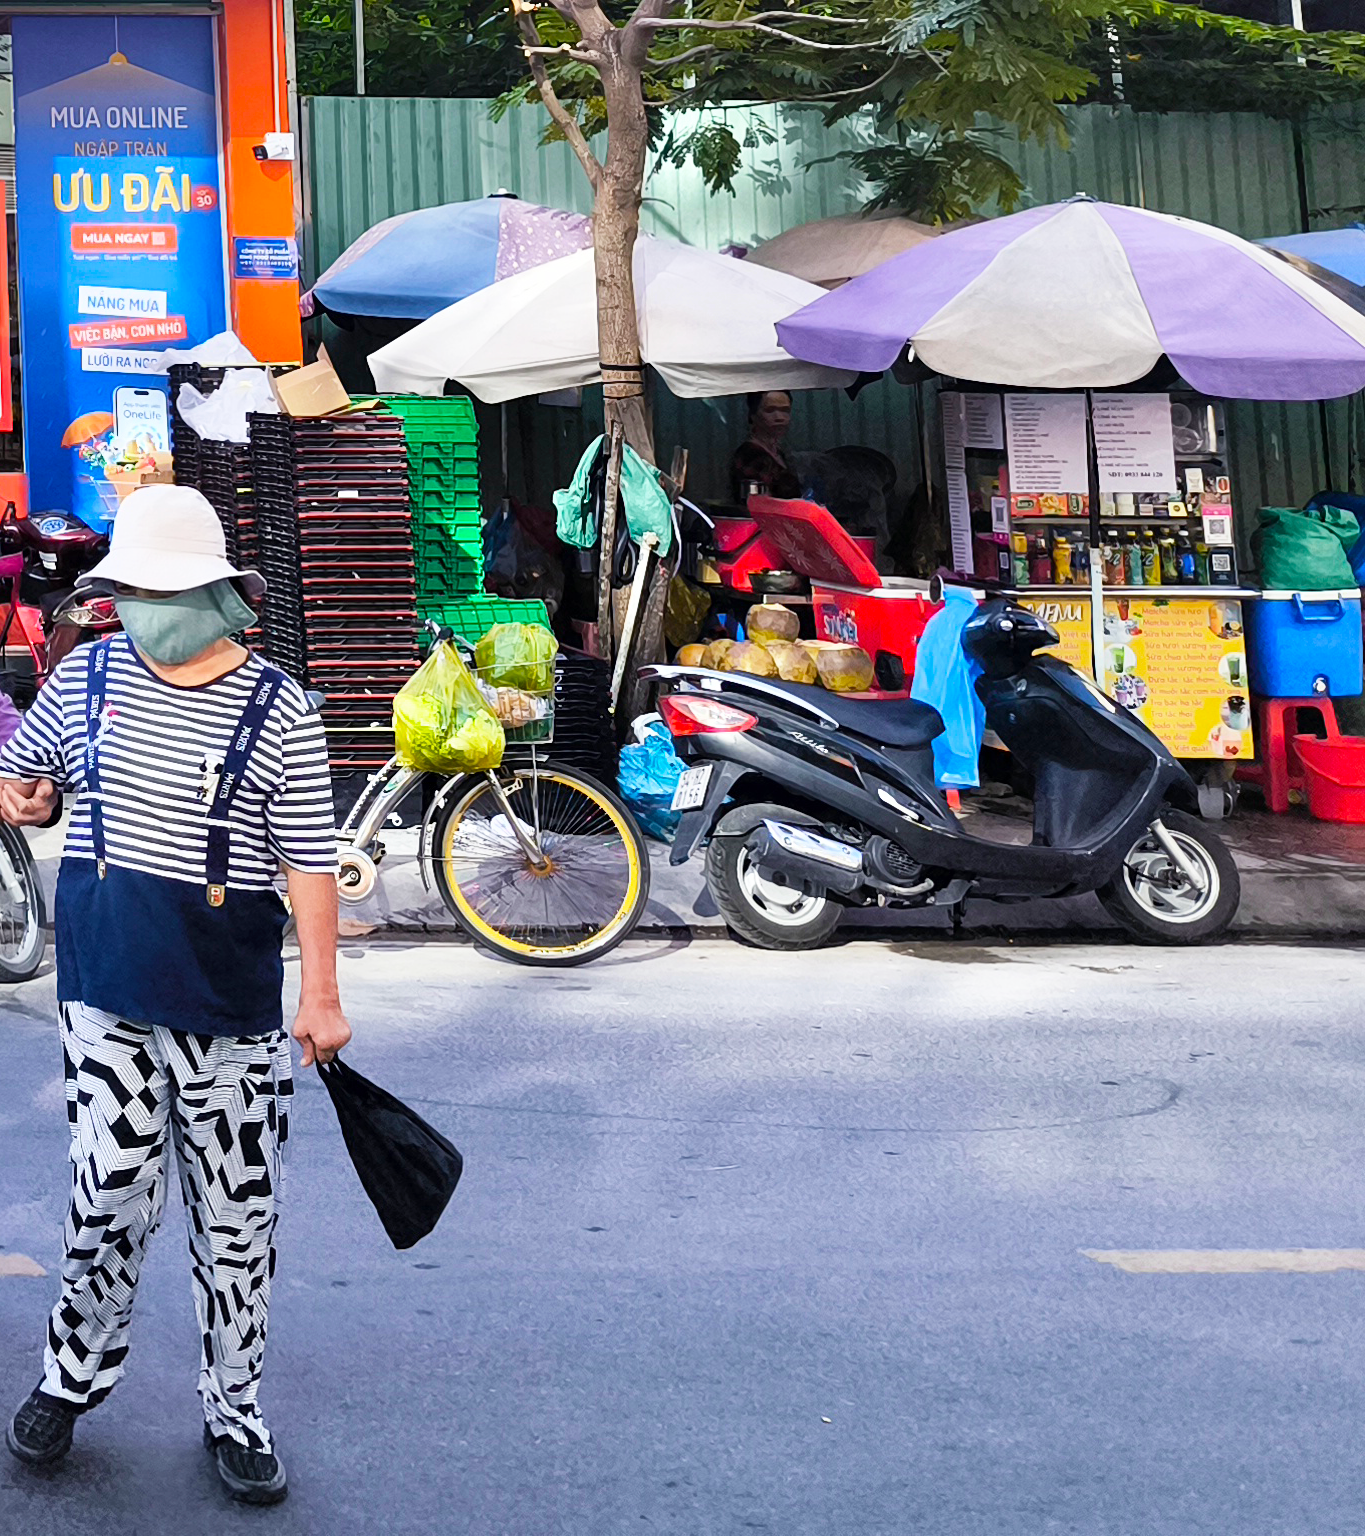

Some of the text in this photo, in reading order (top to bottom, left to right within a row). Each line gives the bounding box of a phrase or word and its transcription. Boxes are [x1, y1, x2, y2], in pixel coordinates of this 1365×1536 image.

[50, 106, 189, 129] MUA ONLINE
[74, 139, 168, 160] NGẬP TRÀN
[53, 166, 191, 212] ƯU ĐÃI
[196, 196, 212, 207] 30
[82, 233, 149, 243] MUA NGAY
[88, 291, 159, 312] NẮNG MƯA
[74, 319, 182, 343] VIỆC BẬN, CON NHỎ
[88, 352, 131, 367] LƯỜI RA
[123, 410, 161, 420] OneLife
[95, 648, 105, 673] PARIS
[256, 681, 273, 707] PARIS
[90, 694, 100, 719] PARIS
[235, 726, 253, 752] PARIS
[220, 772, 235, 799] PARIS
